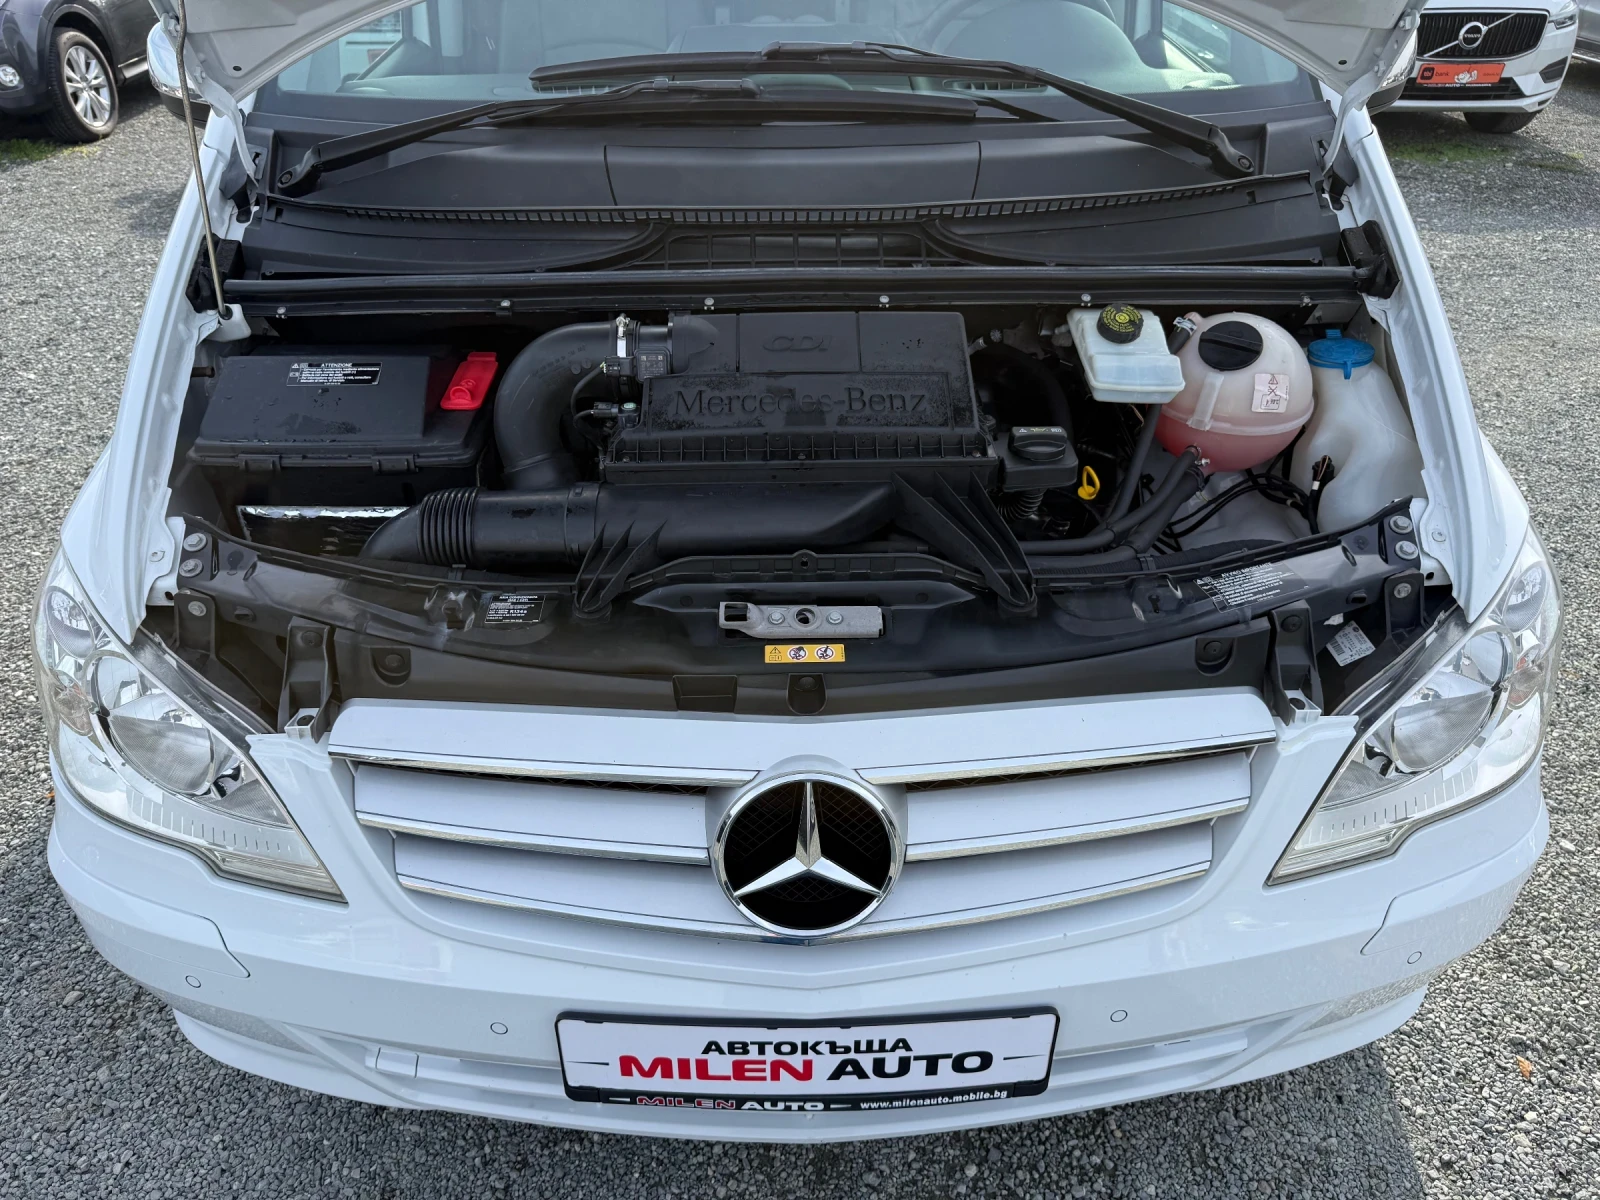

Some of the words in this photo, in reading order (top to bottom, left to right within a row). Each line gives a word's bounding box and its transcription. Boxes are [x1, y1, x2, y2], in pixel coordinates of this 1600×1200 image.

[674, 386, 928, 416] Mercedes-Benz
[701, 1037, 914, 1056] АВТОКЪЩА
[619, 1055, 813, 1082] MILEN
[826, 1050, 994, 1081] AUTO
[636, 1096, 736, 1109] MILEN
[740, 1101, 825, 1111] AUTO
[860, 1088, 1008, 1110] www.milenauto.mobile.bg
